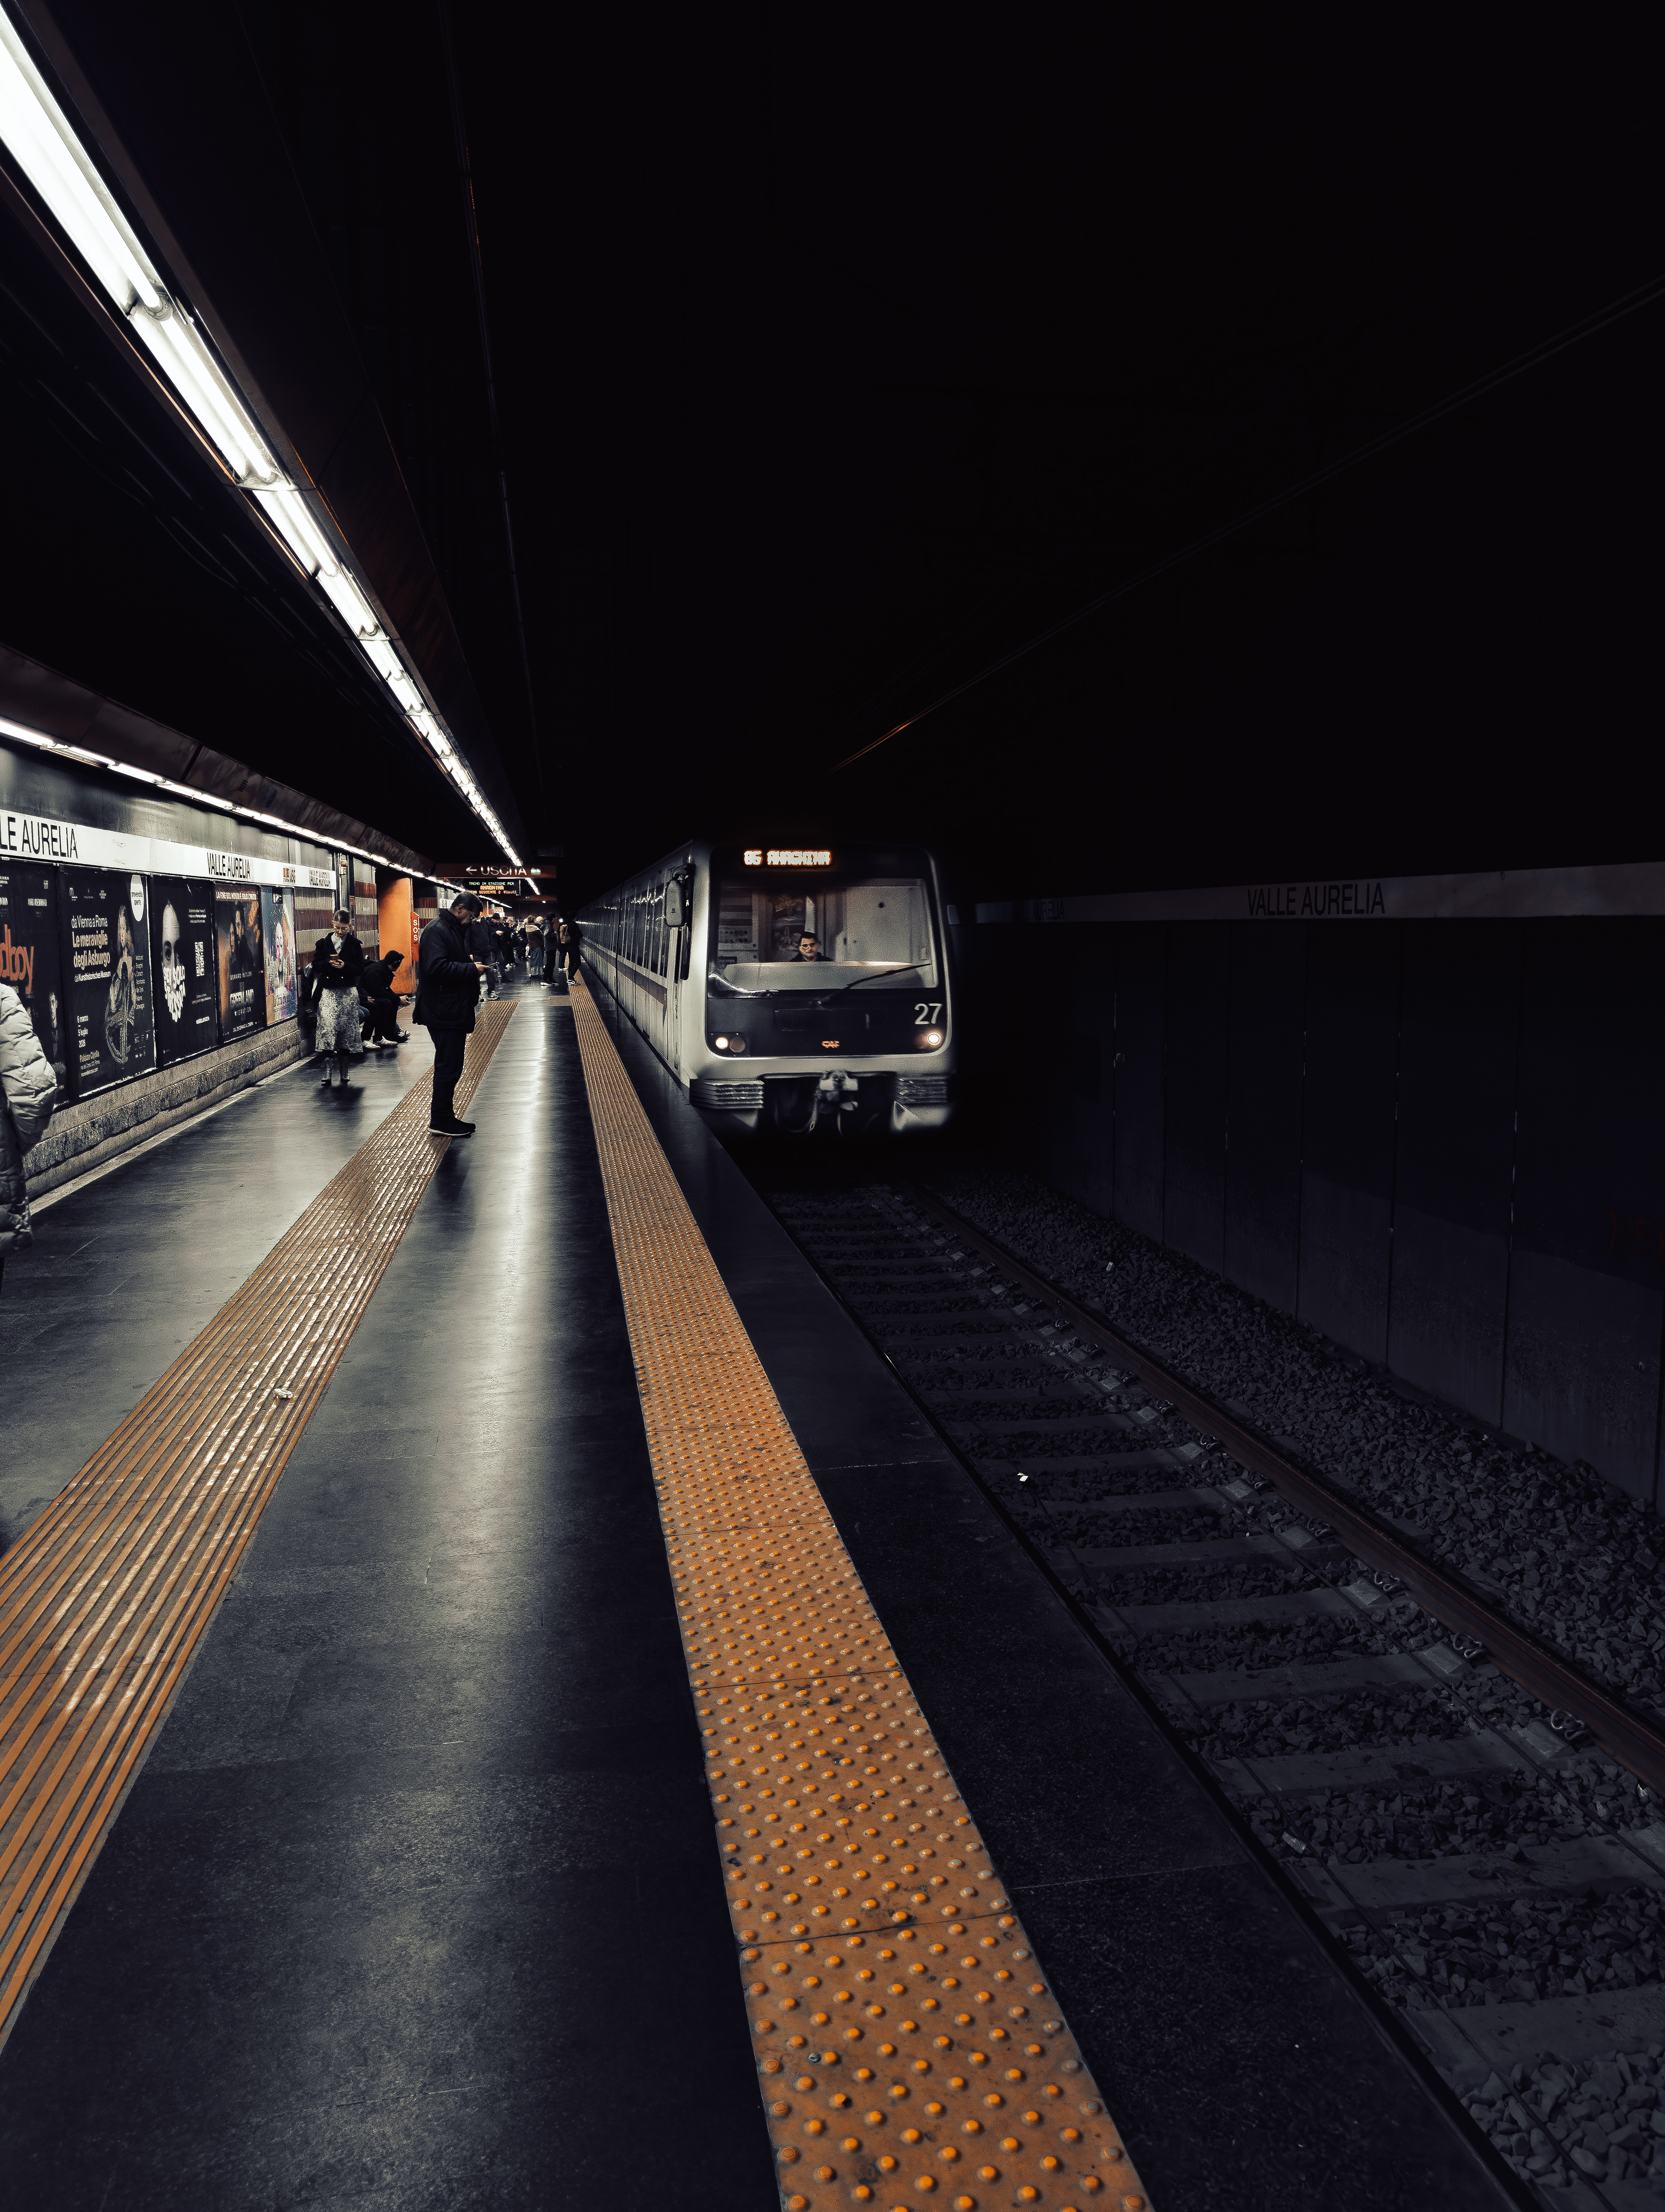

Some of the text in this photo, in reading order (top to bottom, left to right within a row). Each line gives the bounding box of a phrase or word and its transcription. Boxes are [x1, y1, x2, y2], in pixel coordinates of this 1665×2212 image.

[22, 819, 78, 859] AURELIA
[207, 852, 251, 879] VALLE AURELIA
[480, 866, 527, 876] USCITA
[1247, 882, 1385, 916] VALLE AURELIA
[71, 915, 108, 928] da Vienna a Roma
[72, 930, 108, 949] Le meraviglie
[74, 949, 111, 971] degli Asburgo
[230, 989, 254, 1007] GREENLAND
[77, 1015, 80, 1023] 6
[914, 1003, 943, 1024] 27
